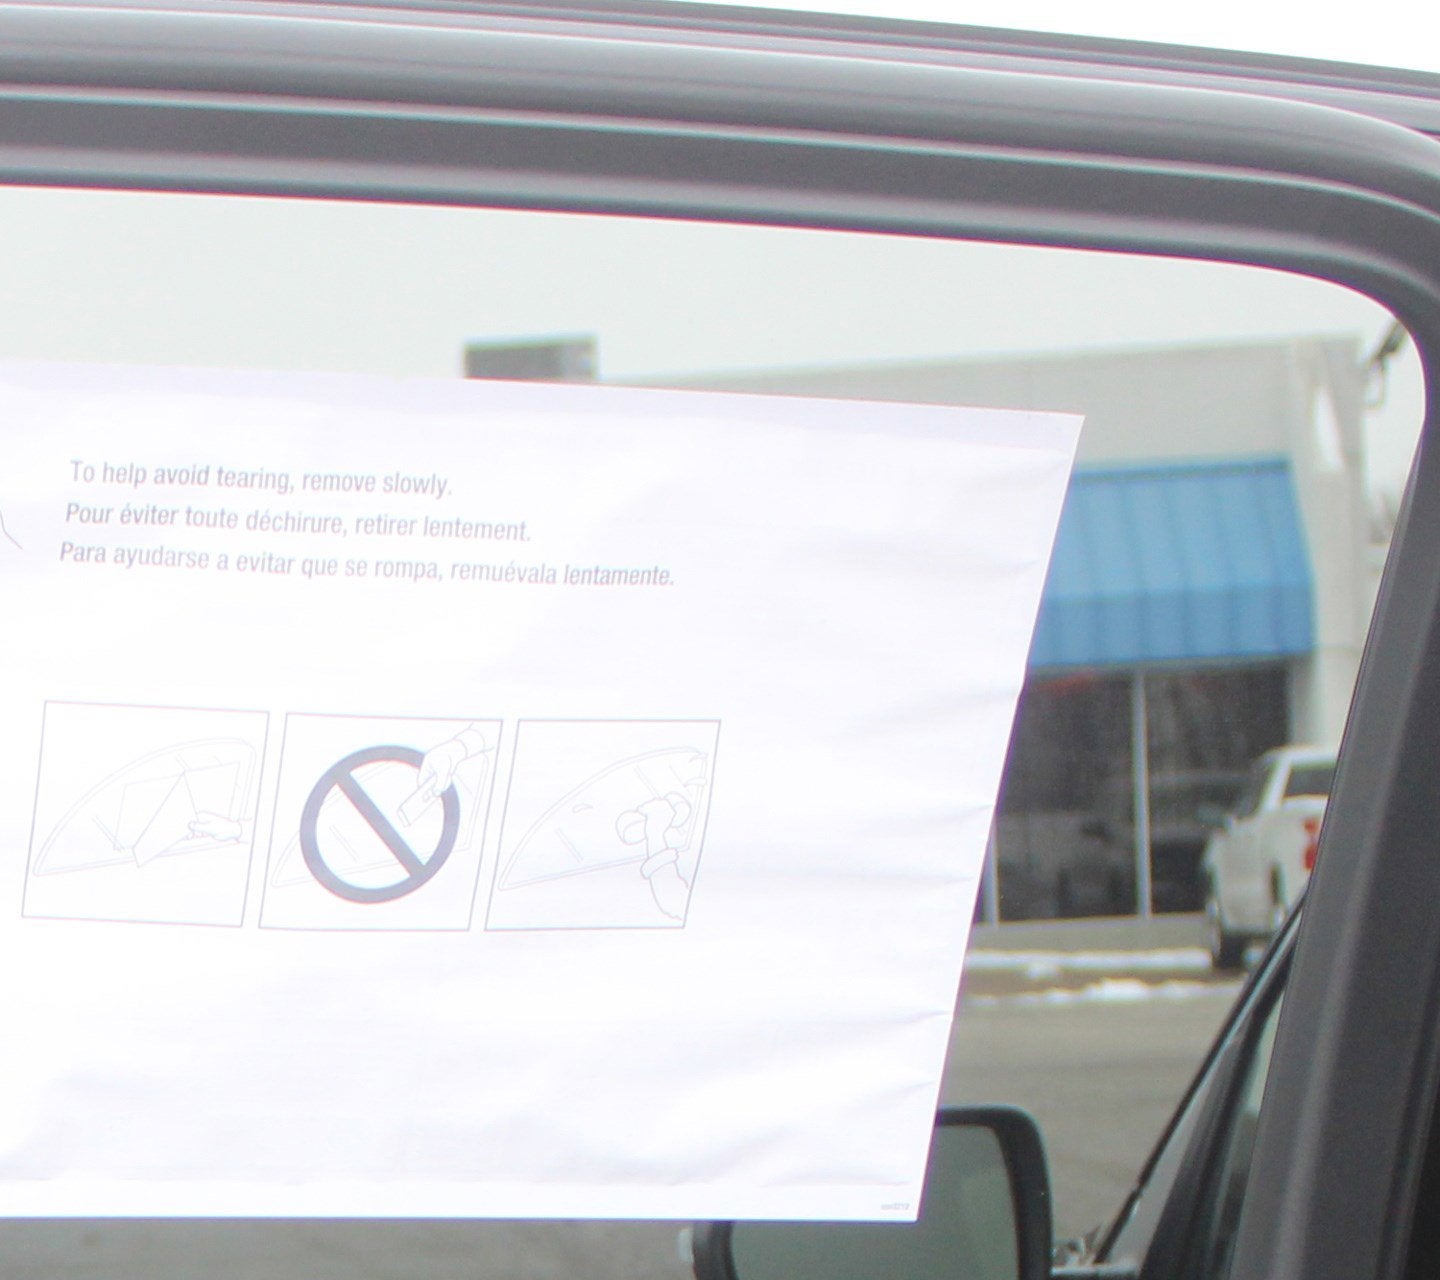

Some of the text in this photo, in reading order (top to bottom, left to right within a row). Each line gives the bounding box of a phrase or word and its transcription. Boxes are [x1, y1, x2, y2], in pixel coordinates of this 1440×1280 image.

[71, 460, 452, 500] To help avoid tearing, remove slowly.
[66, 502, 531, 542] Pour éviter toute déchirure, retirer lentement.
[60, 541, 675, 587] Para ayudarse a evitar que se rompa, remuévala lentamente.
